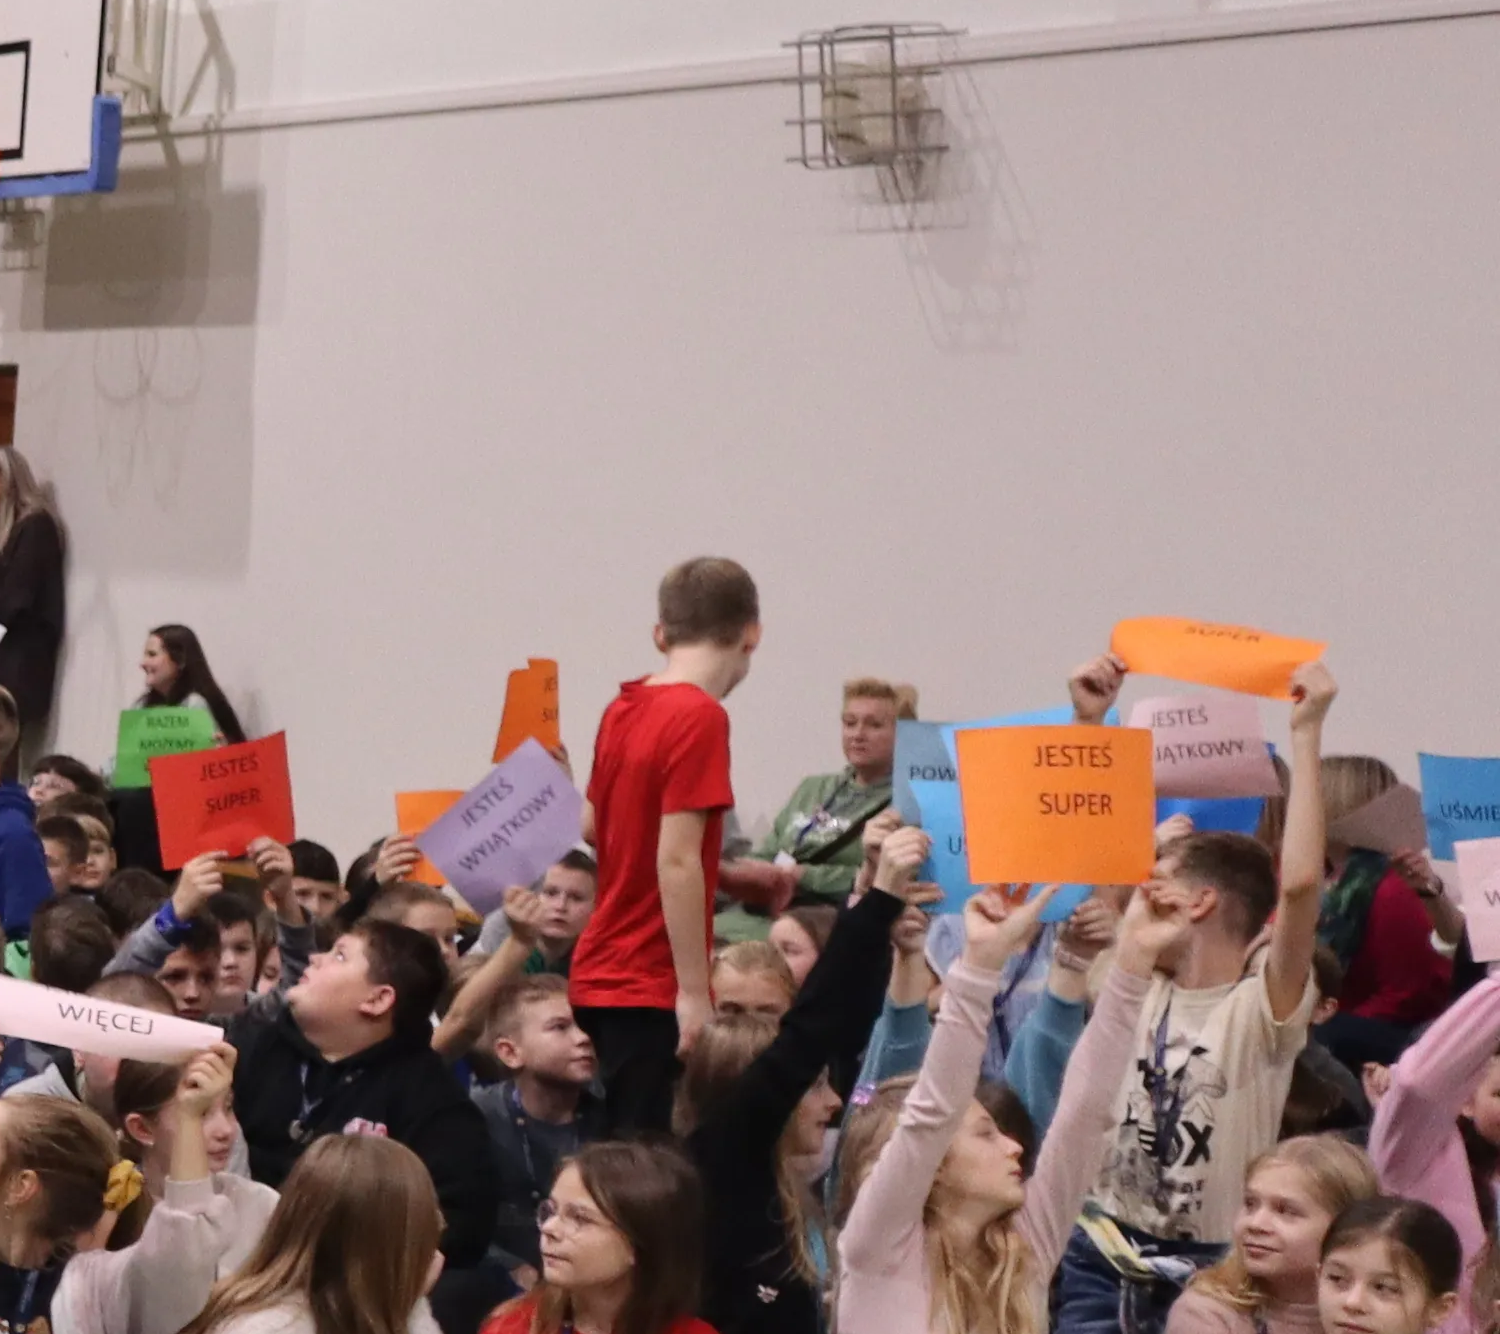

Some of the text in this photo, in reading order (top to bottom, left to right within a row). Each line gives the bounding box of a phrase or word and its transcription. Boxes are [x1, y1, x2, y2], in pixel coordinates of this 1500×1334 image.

[1034, 744, 1114, 769] JESTEŚ
[1156, 739, 1245, 765] JĄTKOWY
[198, 752, 261, 783] JESTEŚ
[205, 788, 262, 816] SUPER
[461, 776, 516, 830] JESTEŚ
[1039, 792, 1113, 816] SUPER
[458, 783, 559, 874] WYJĄTKOWY
[57, 1002, 154, 1036] WIĘCEJ
